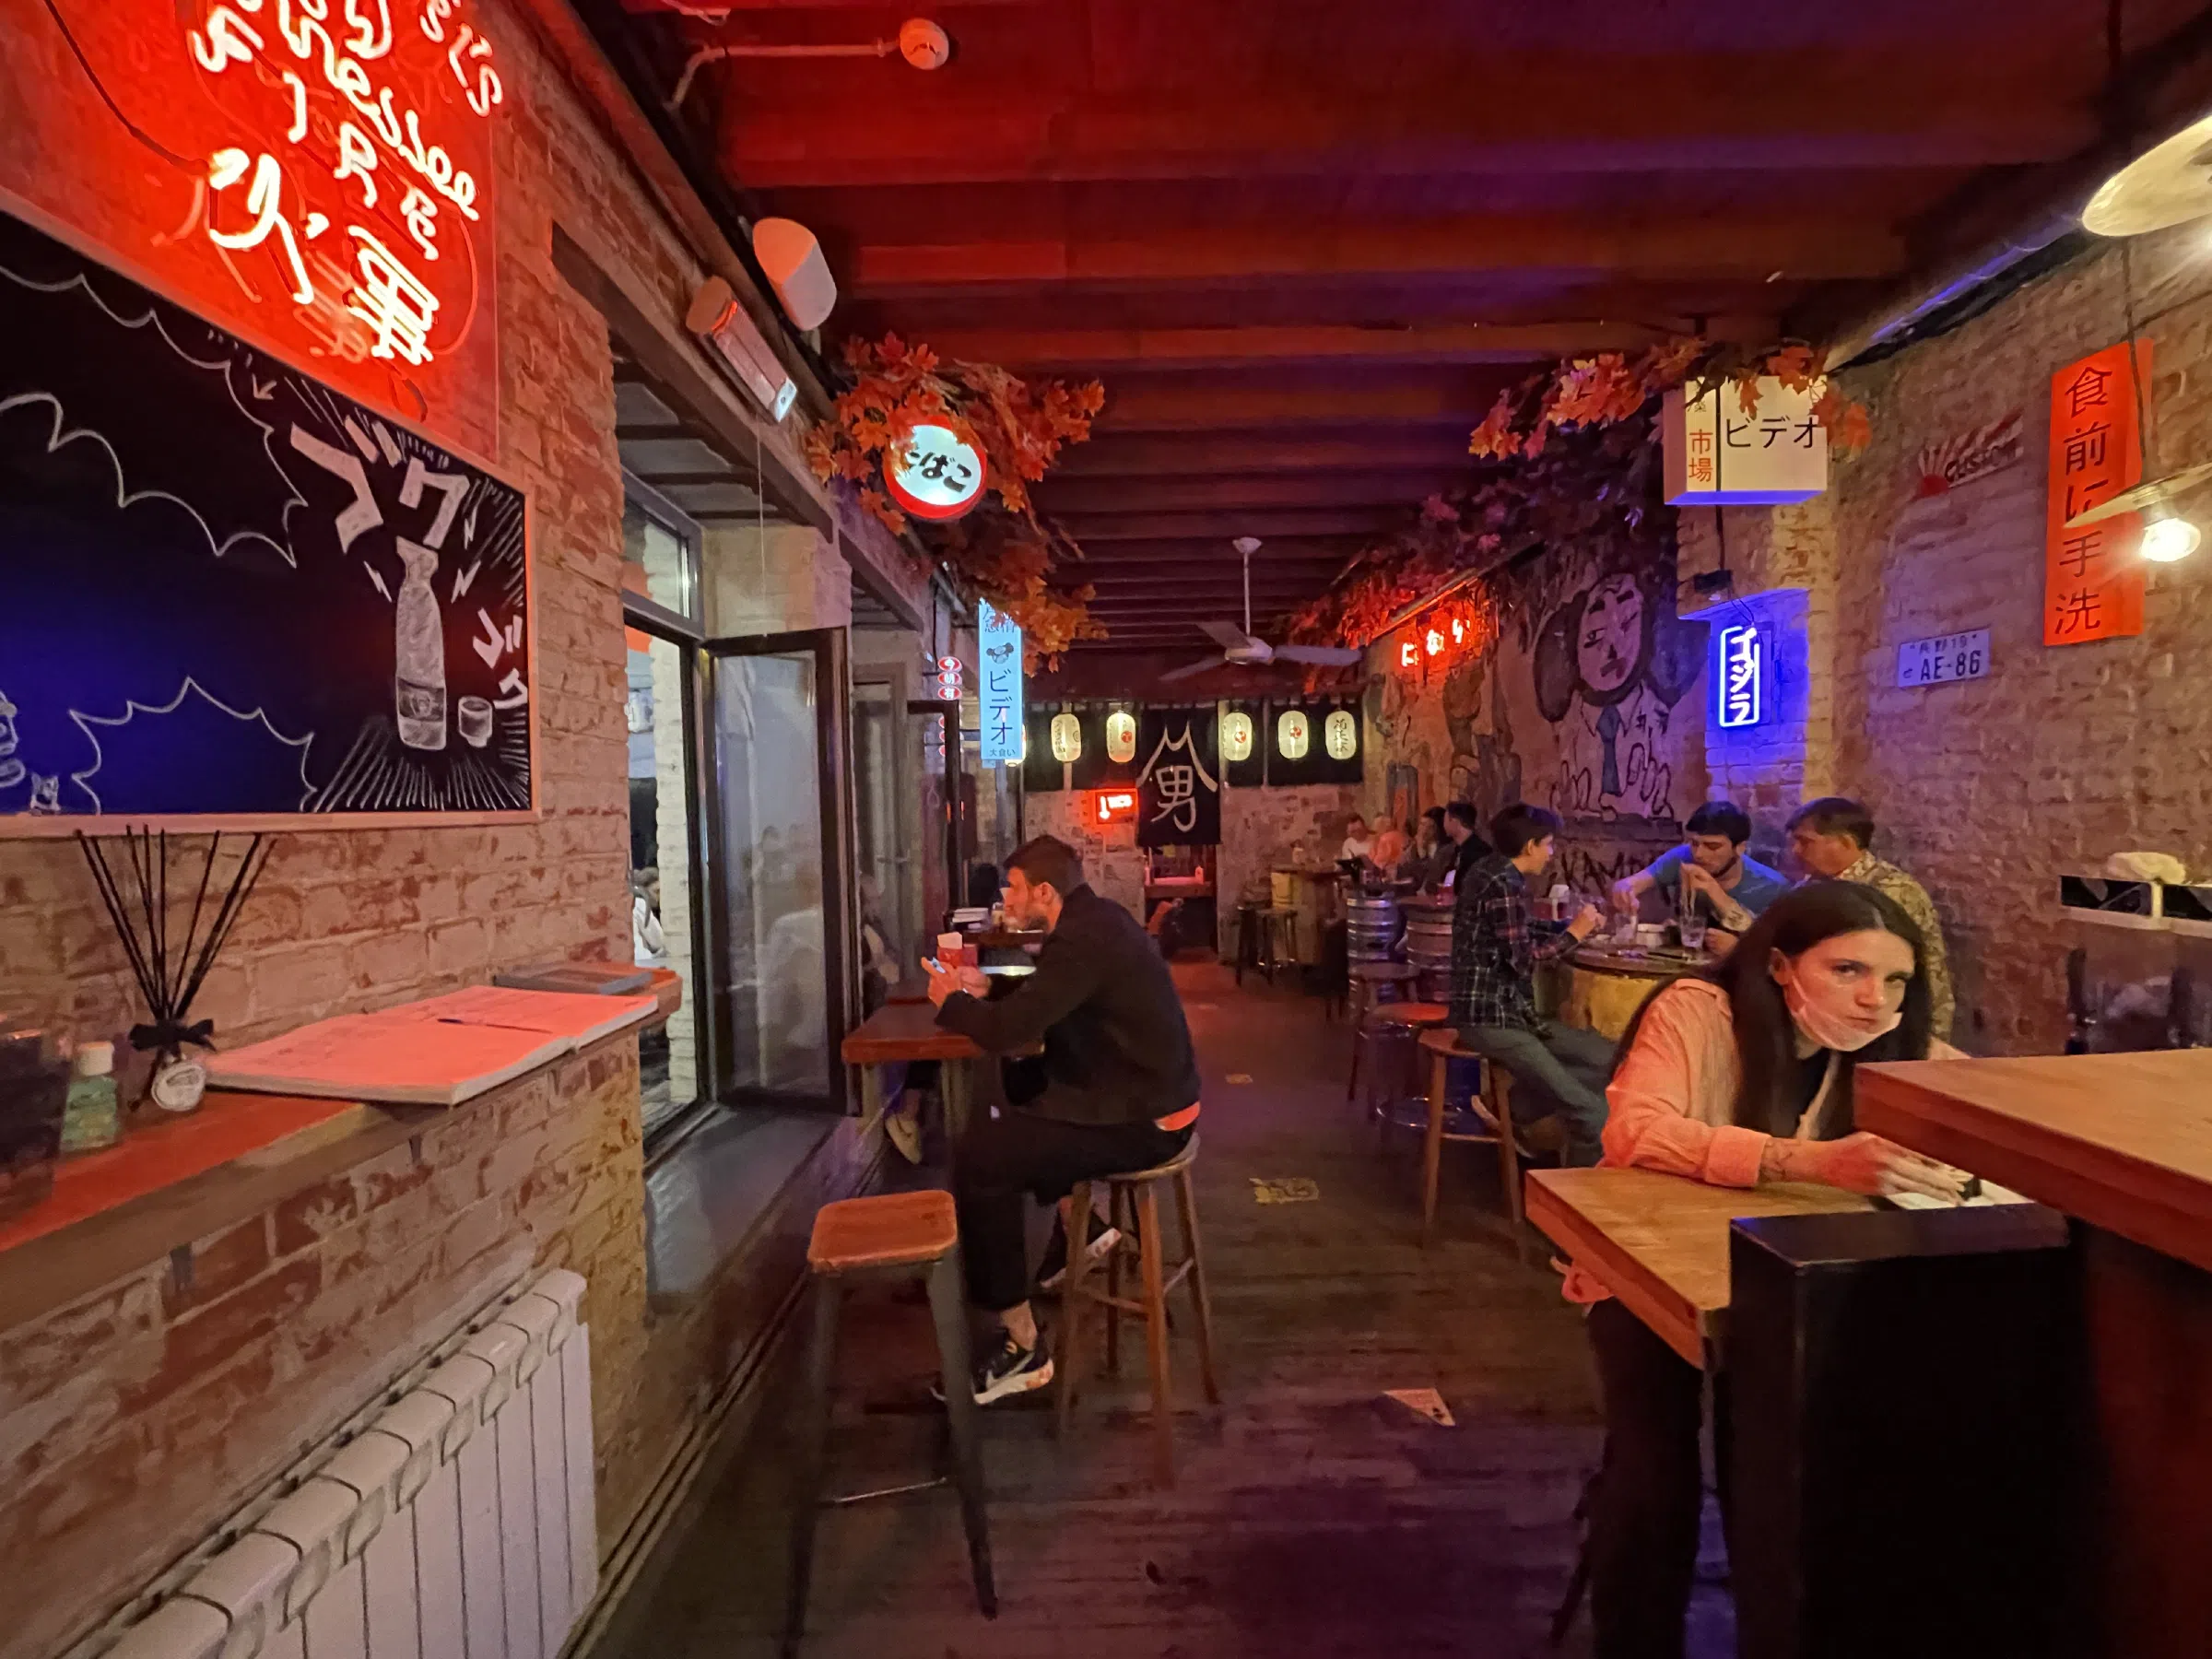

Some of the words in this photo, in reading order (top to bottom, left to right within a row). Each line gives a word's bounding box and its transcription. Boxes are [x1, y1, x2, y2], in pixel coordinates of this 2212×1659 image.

[188, 6, 439, 262] FIRE
[1688, 429, 1713, 482] 市場
[1726, 415, 1819, 449] ビデオ
[1729, 627, 1758, 723] ゴジラ
[1920, 650, 1982, 681] AE-86
[989, 668, 1014, 746] ビデオ
